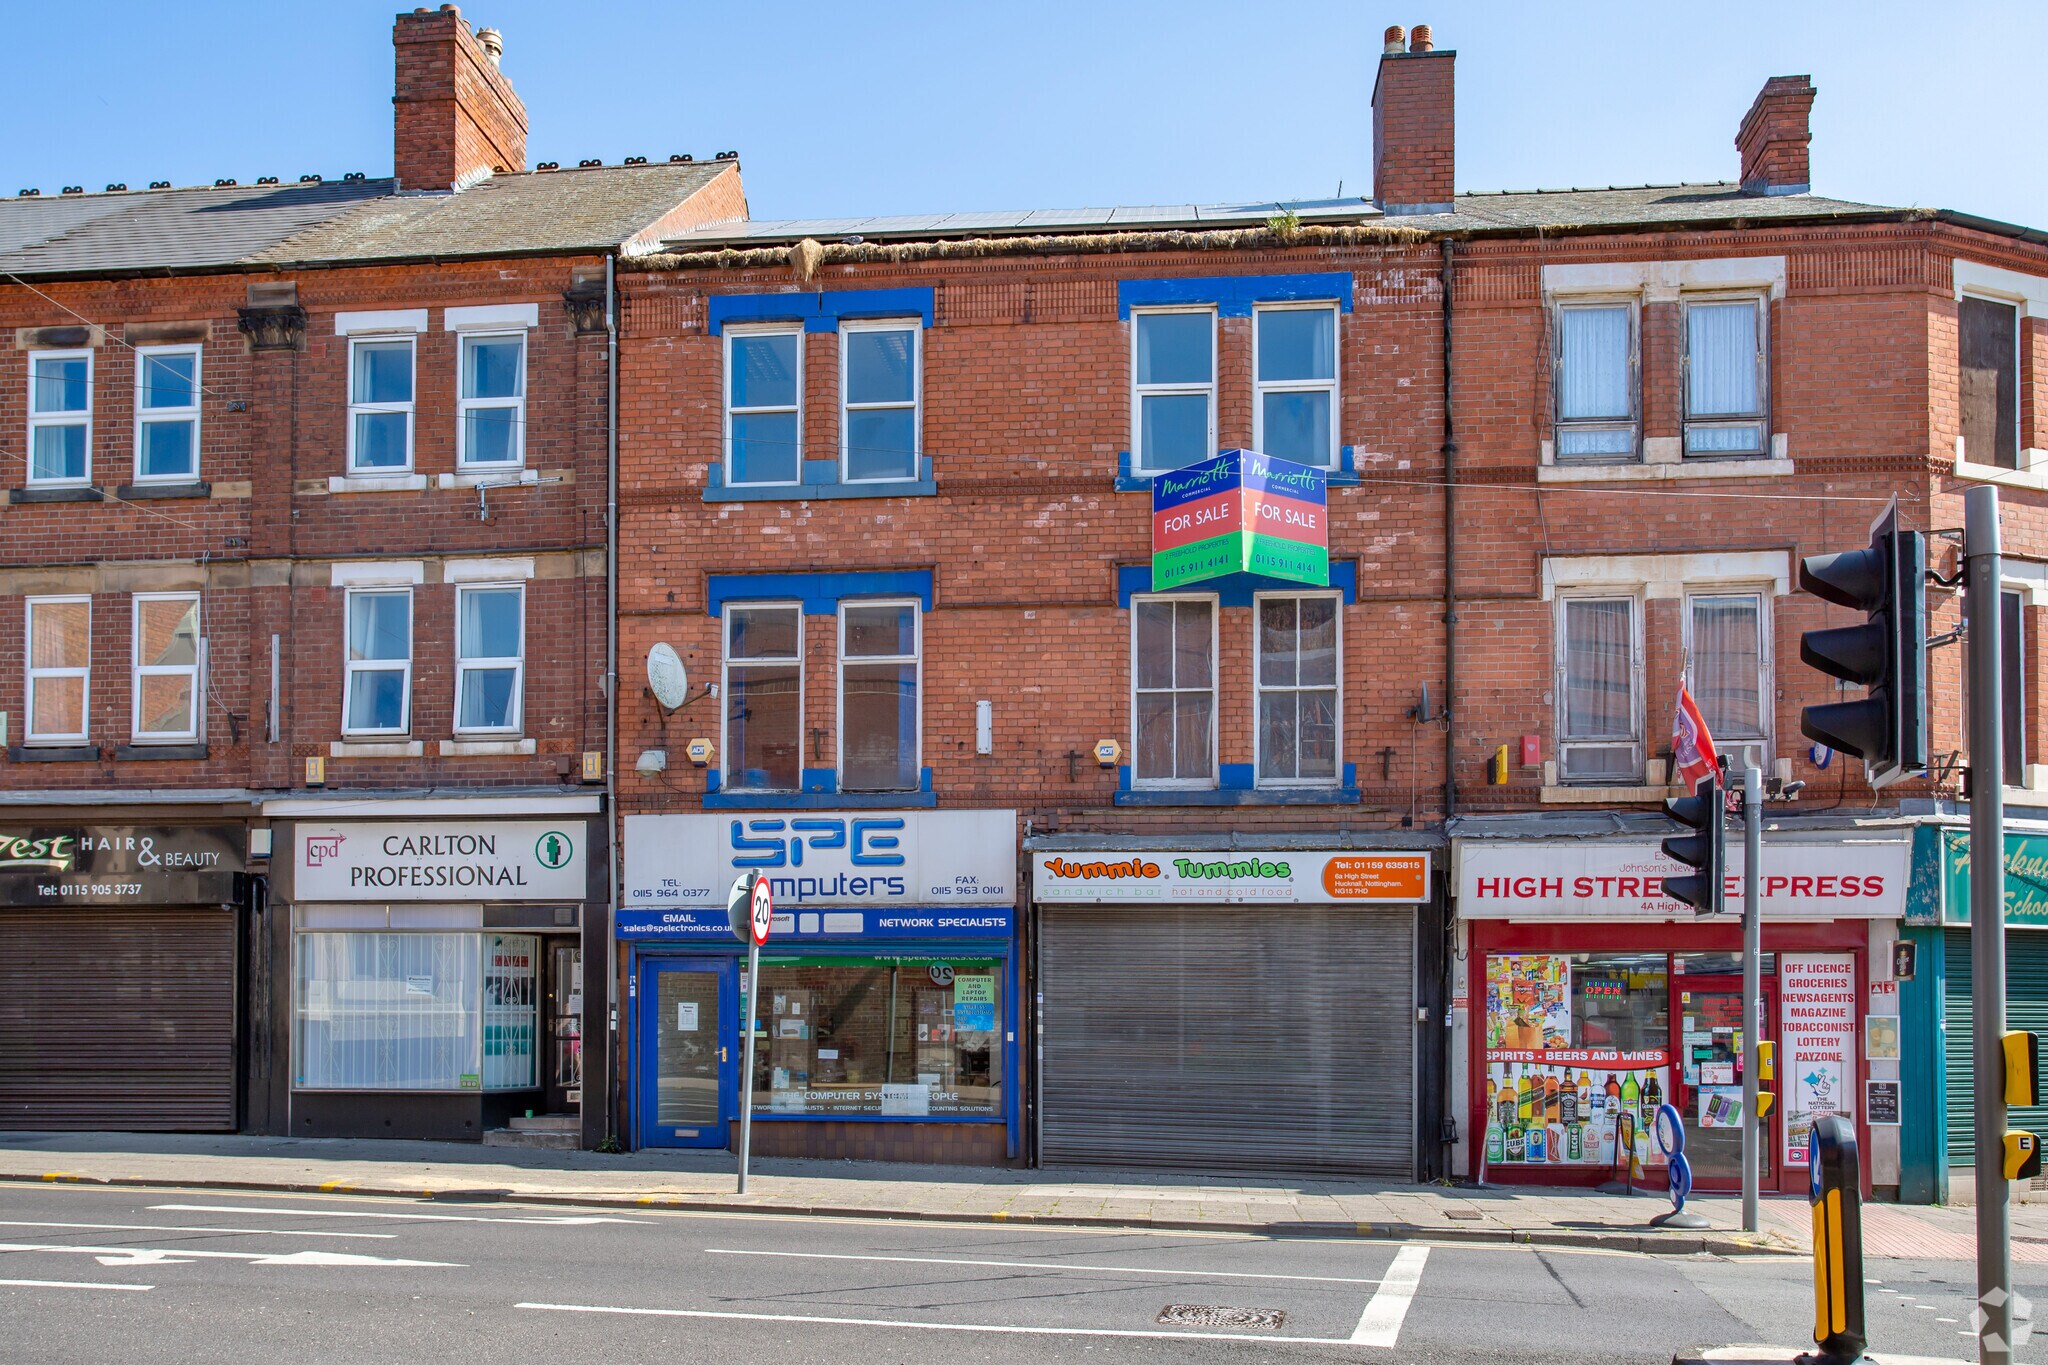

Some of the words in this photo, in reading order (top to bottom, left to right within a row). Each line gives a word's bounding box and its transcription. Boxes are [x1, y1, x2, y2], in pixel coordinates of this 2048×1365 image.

[1161, 457, 1234, 497] Marriotts
[1252, 458, 1318, 491] Marriotts
[1182, 487, 1211, 499] COMMERCIAL
[1271, 484, 1300, 494] COMMERCIAL
[1164, 514, 1191, 534] FOR
[1195, 503, 1229, 525] SALE
[1254, 502, 1281, 522] FOR
[1286, 512, 1316, 529] SALE
[1169, 546, 1197, 558] FREEHOLD
[1198, 538, 1229, 551] PROPERTIES
[1260, 539, 1287, 550] FREEHOLD
[1287, 543, 1316, 556] PROPERTIES
[1165, 565, 1185, 578] 0115
[1188, 561, 1203, 572] 911
[1208, 554, 1228, 568] 4141
[1256, 553, 1275, 566] 0115
[1279, 558, 1293, 569] 911
[1296, 562, 1316, 573] 4141
[692, 746, 704, 754] ADT
[1100, 747, 1113, 755] ADT
[383, 835, 496, 856] CARLTON
[731, 818, 905, 868] SPE
[81, 837, 135, 850] HAIR
[137, 837, 162, 866] &
[165, 852, 220, 866] BEAUTY
[310, 840, 339, 863] cpd
[1044, 857, 1161, 879] Yummie
[1173, 857, 1291, 879] Tummies
[1354, 861, 1382, 869] 01159
[1385, 861, 1420, 869] 635815
[1619, 863, 1667, 873] Johnson's
[351, 865, 528, 887] PROFESSIONAL
[955, 876, 979, 884] FAX:
[1344, 873, 1359, 881] High
[662, 879, 681, 887] TEL:
[770, 872, 905, 902] mputers
[1477, 877, 1563, 898] HIGH
[1573, 875, 1671, 899] STRE
[1724, 875, 1884, 898] EPRESS
[38, 884, 58, 896] Tel:
[60, 884, 88, 895] 0115
[91, 884, 111, 895] 905
[114, 883, 142, 894] 3737
[632, 889, 652, 898] 0115
[656, 889, 679, 898] 964
[683, 888, 710, 897] 0377
[931, 886, 952, 895] 0115
[956, 886, 978, 895] 963
[982, 886, 1004, 894] 0101
[1043, 887, 1124, 896] sandwich
[1134, 887, 1161, 896] bar
[1172, 888, 1193, 896] hot
[1198, 888, 1222, 896] and
[1227, 887, 1257, 896] cold
[1262, 887, 1292, 896] food
[755, 895, 769, 925] 20
[1641, 902, 1654, 911] 4A
[1658, 902, 1680, 912] High
[663, 914, 696, 923] EMAIL:
[879, 918, 934, 927] NETWORK
[938, 917, 1006, 927] SPECIALISTS
[1785, 964, 1803, 973] OFF
[1807, 964, 1851, 973] LICENCE
[1789, 979, 1848, 988] GROCERIES
[1586, 987, 1621, 995] OPEN
[1782, 993, 1854, 1003] NEWSAGENTS
[1791, 1008, 1846, 1017] MAGAZINE
[1783, 1022, 1855, 1032] TOBACCONIST
[1797, 1037, 1840, 1047] LOTTERY
[1487, 1051, 1534, 1061] SPIRITS
[1546, 1051, 1588, 1061] BEERS
[1592, 1051, 1618, 1061] AND
[1621, 1051, 1662, 1061] WINES
[1795, 1052, 1842, 1062] PAYZONE
[781, 1092, 799, 1100] THE
[804, 1092, 860, 1100] COMPUTER
[928, 1092, 958, 1100] EOPLE
[2020, 1137, 2031, 1149] E
